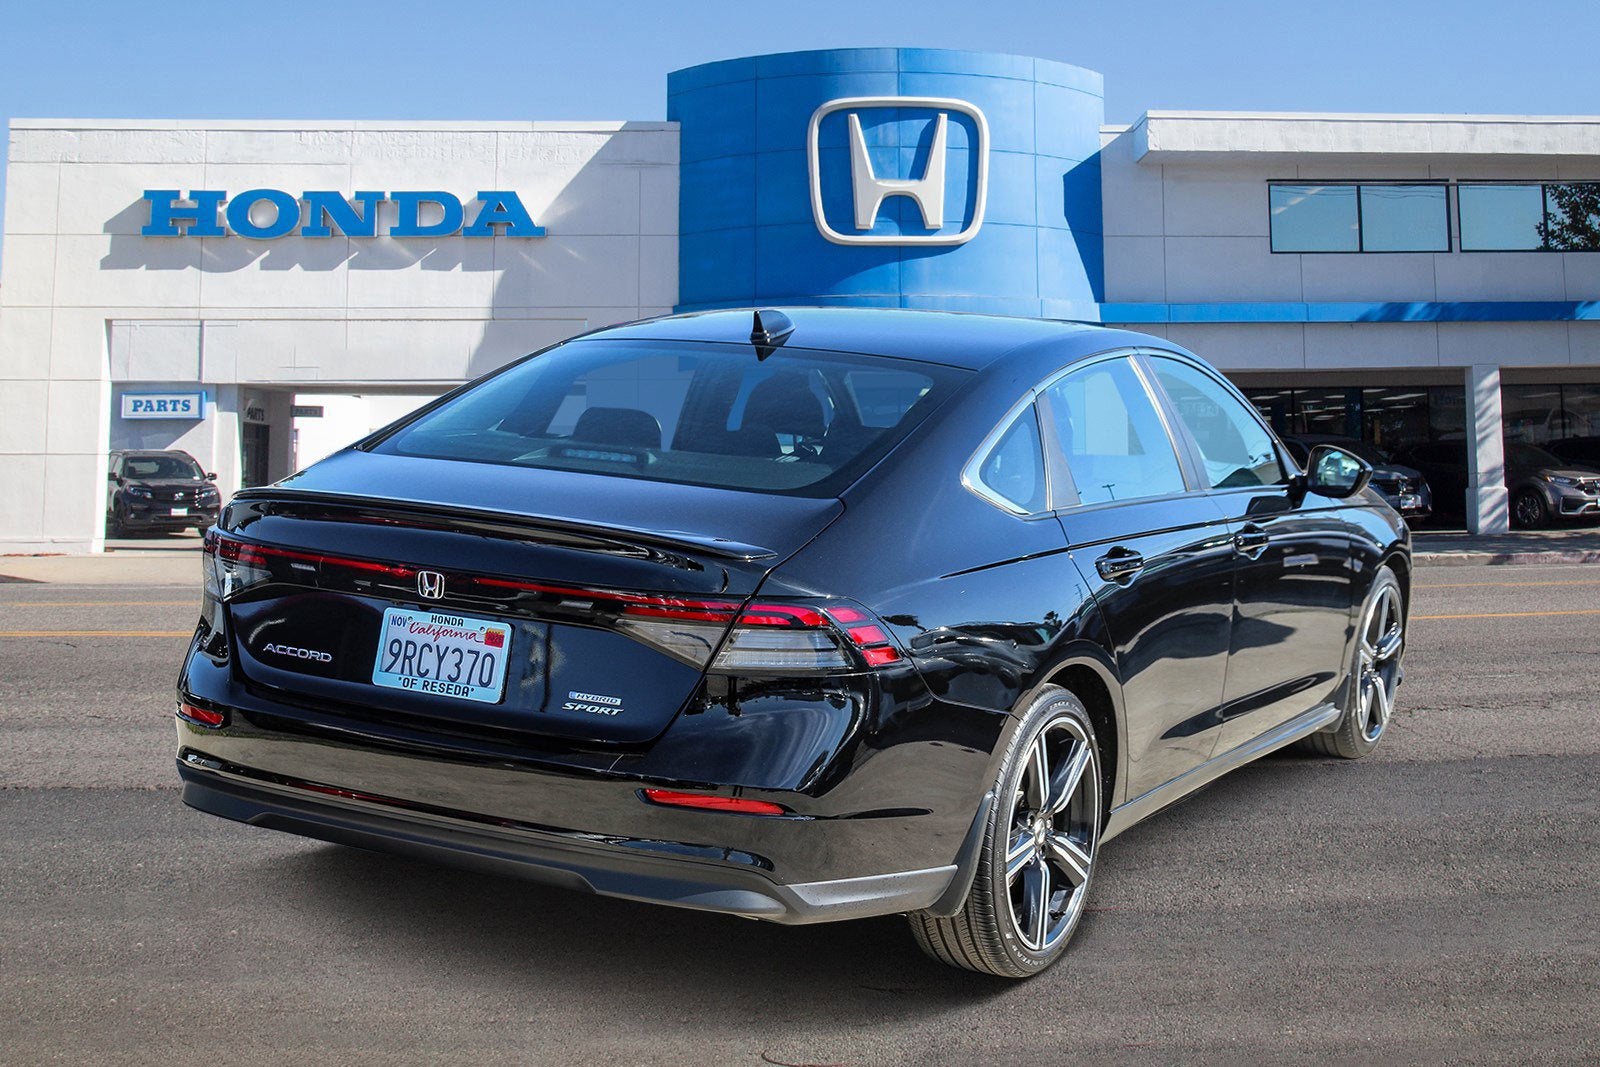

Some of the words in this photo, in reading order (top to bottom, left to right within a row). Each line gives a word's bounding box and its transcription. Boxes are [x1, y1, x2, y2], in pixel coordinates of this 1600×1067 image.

[141, 188, 547, 239] HONDA
[131, 399, 191, 412] PARTS
[391, 615, 407, 628] NOV
[431, 614, 464, 627] HONDA
[409, 621, 485, 643] California
[262, 643, 332, 662] ACCORD
[385, 638, 496, 688] 9RCY370
[576, 693, 619, 704] HYBRID
[562, 702, 624, 715] SPORT
